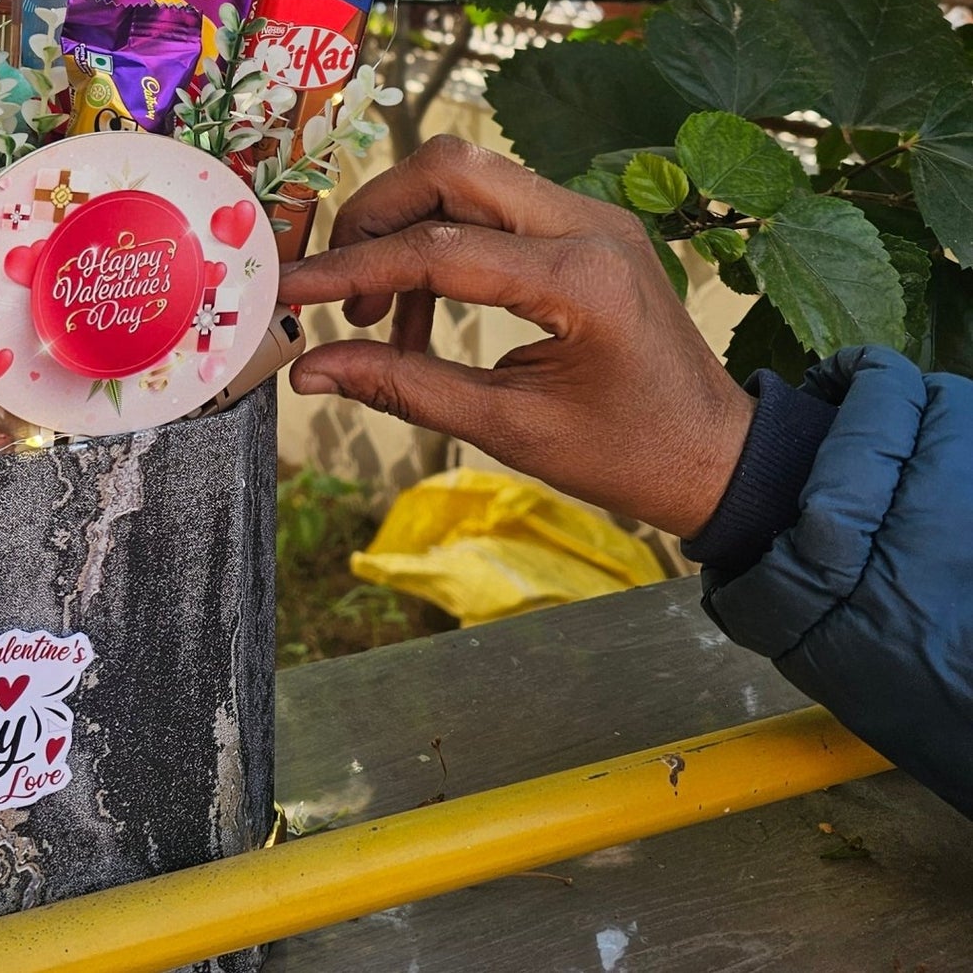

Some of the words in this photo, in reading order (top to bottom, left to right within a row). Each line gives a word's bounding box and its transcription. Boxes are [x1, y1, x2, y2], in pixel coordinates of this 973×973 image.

[262, 28, 355, 87] itKat
[140, 76, 161, 121] Cadbury
[76, 246, 163, 279] Happy
[52, 264, 171, 308] Valentine's
[86, 299, 144, 334] Day
